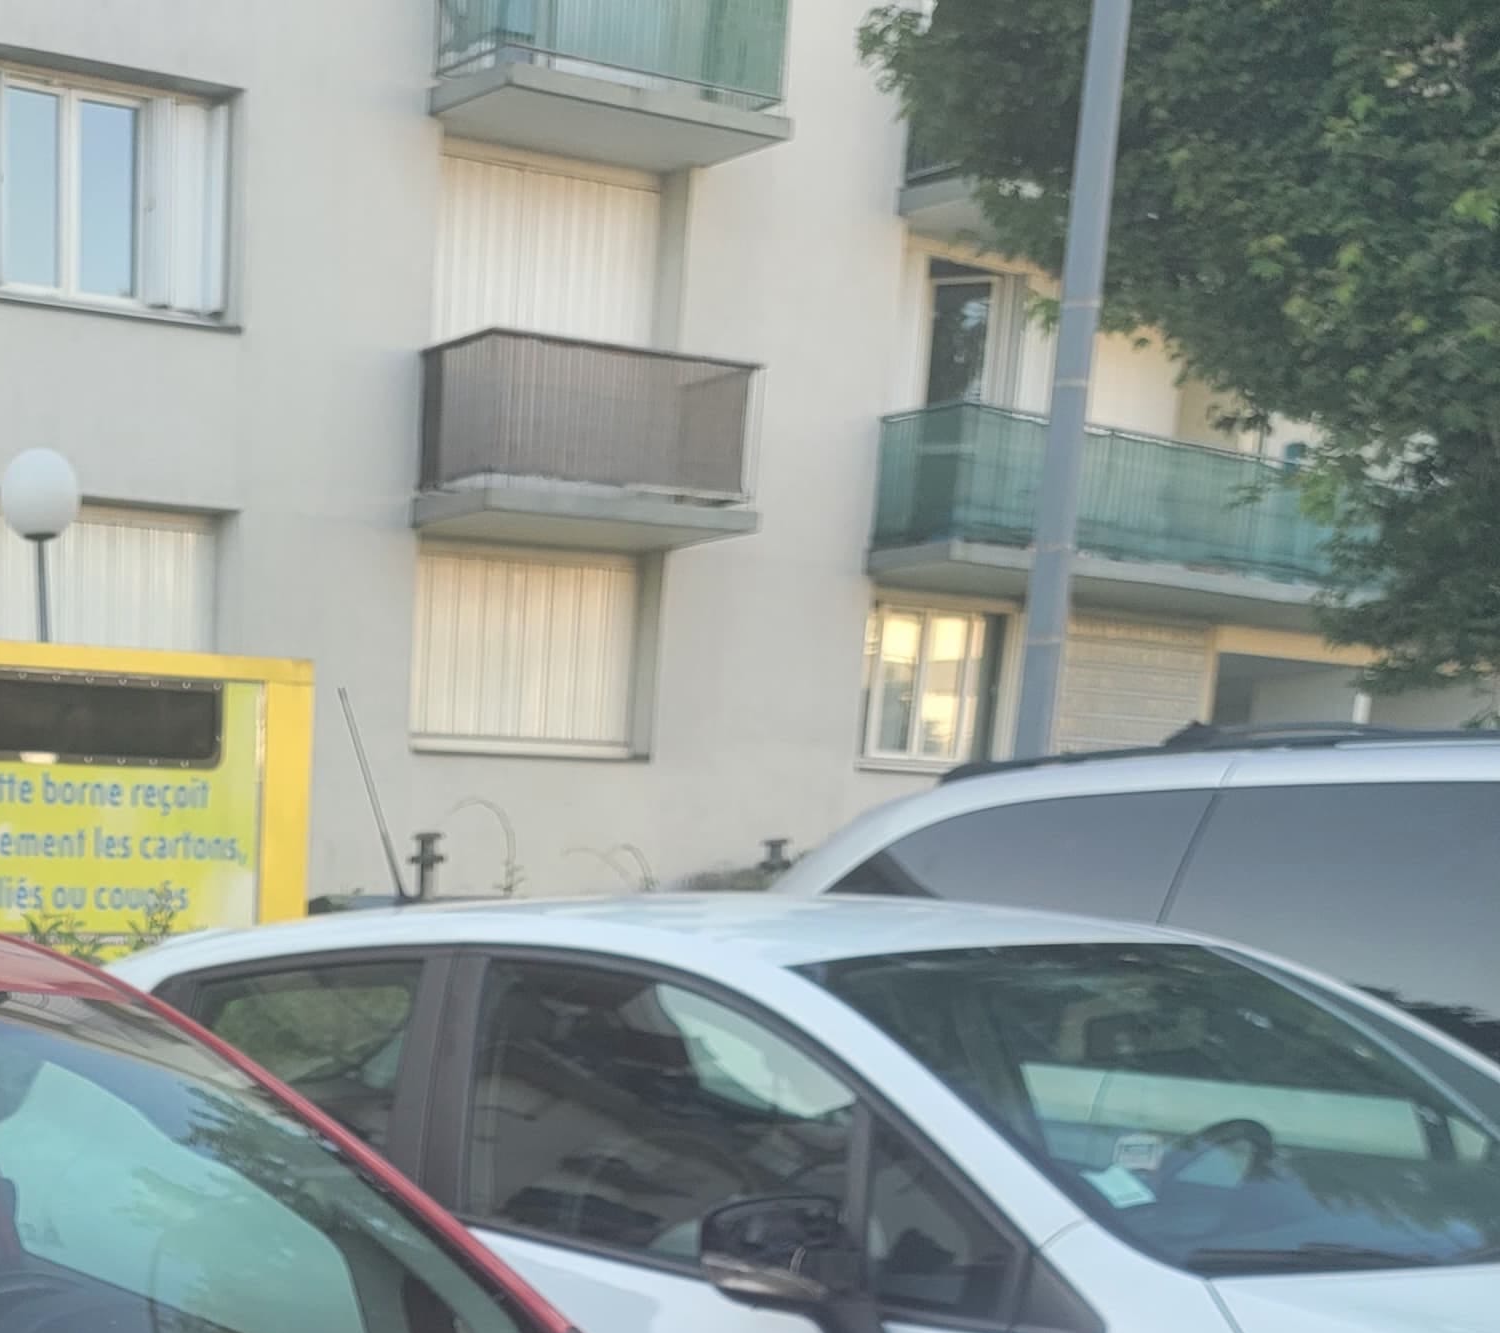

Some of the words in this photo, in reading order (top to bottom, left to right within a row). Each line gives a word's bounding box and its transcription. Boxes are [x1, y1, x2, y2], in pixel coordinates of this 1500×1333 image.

[41, 773, 122, 808] borne
[129, 778, 211, 817] reçoit
[93, 827, 132, 859] les
[51, 884, 87, 909] ou
